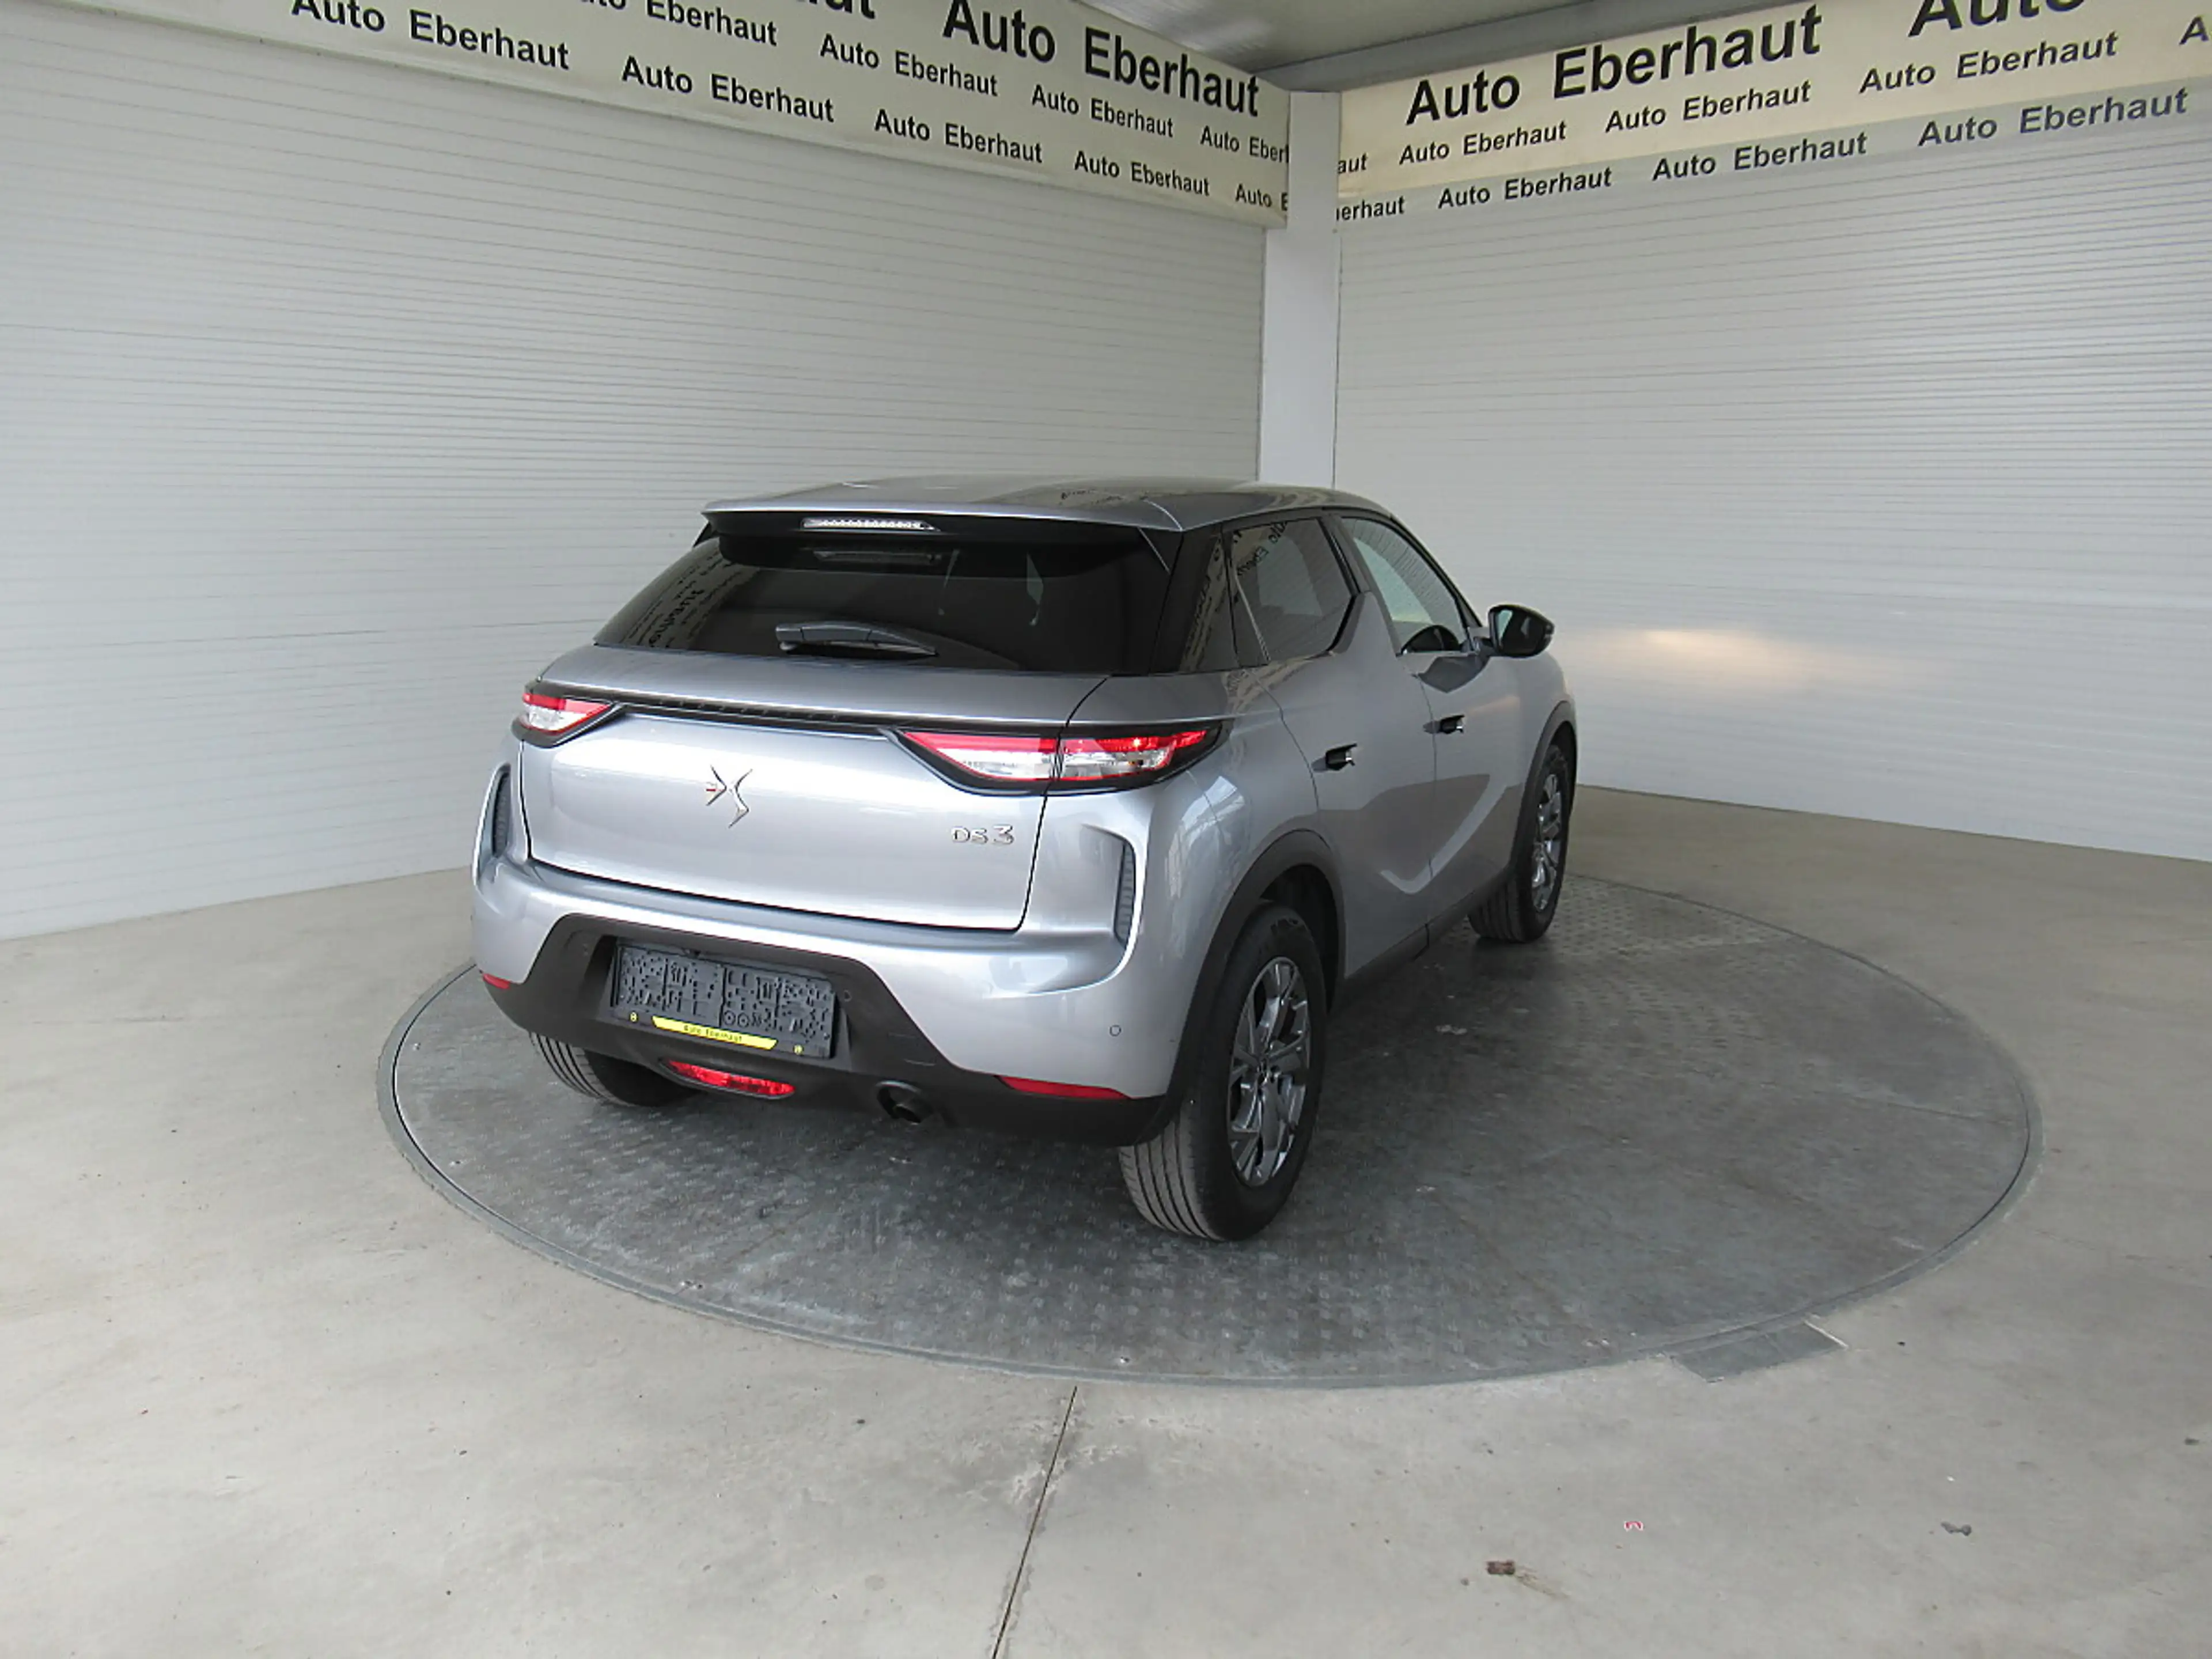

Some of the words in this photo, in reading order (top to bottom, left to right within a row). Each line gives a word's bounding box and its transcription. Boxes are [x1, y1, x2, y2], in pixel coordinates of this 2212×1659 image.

[291, 0, 385, 32] Auto
[410, 9, 569, 70] Eberhaut
[942, 0, 1055, 63] Auto
[1085, 26, 1259, 116] Eberhaut
[622, 55, 692, 94] Auto
[711, 73, 834, 123] Eberhaut
[820, 33, 879, 69] Auto
[895, 50, 998, 97] Eberhaut
[1406, 70, 1520, 126] Auto
[1554, 4, 1821, 99] Eberhaut
[1859, 63, 1936, 94] Auto
[1957, 32, 2118, 78] Eberhaut
[1032, 84, 1079, 115] Auto
[1091, 97, 1173, 138] Eberhaut
[1605, 106, 1666, 133] Auto
[1683, 79, 1810, 120] Eberhaut
[1918, 116, 1997, 146] Auto
[2020, 87, 2188, 134] Eberhaut
[874, 109, 930, 141] Auto
[945, 122, 1042, 164] Eberhaut
[1200, 125, 1240, 153] Auto
[1399, 141, 1449, 165] Auto
[1464, 121, 1566, 156] Eberhaut
[1652, 154, 1716, 181] Auto
[1734, 132, 1867, 170] Eberhaut
[1074, 150, 1119, 178] Auto
[1131, 161, 1209, 196] Eberhaut
[1236, 183, 1272, 208] Auto
[1438, 185, 1490, 209] Auto
[1505, 166, 1612, 199] Eberhaut
